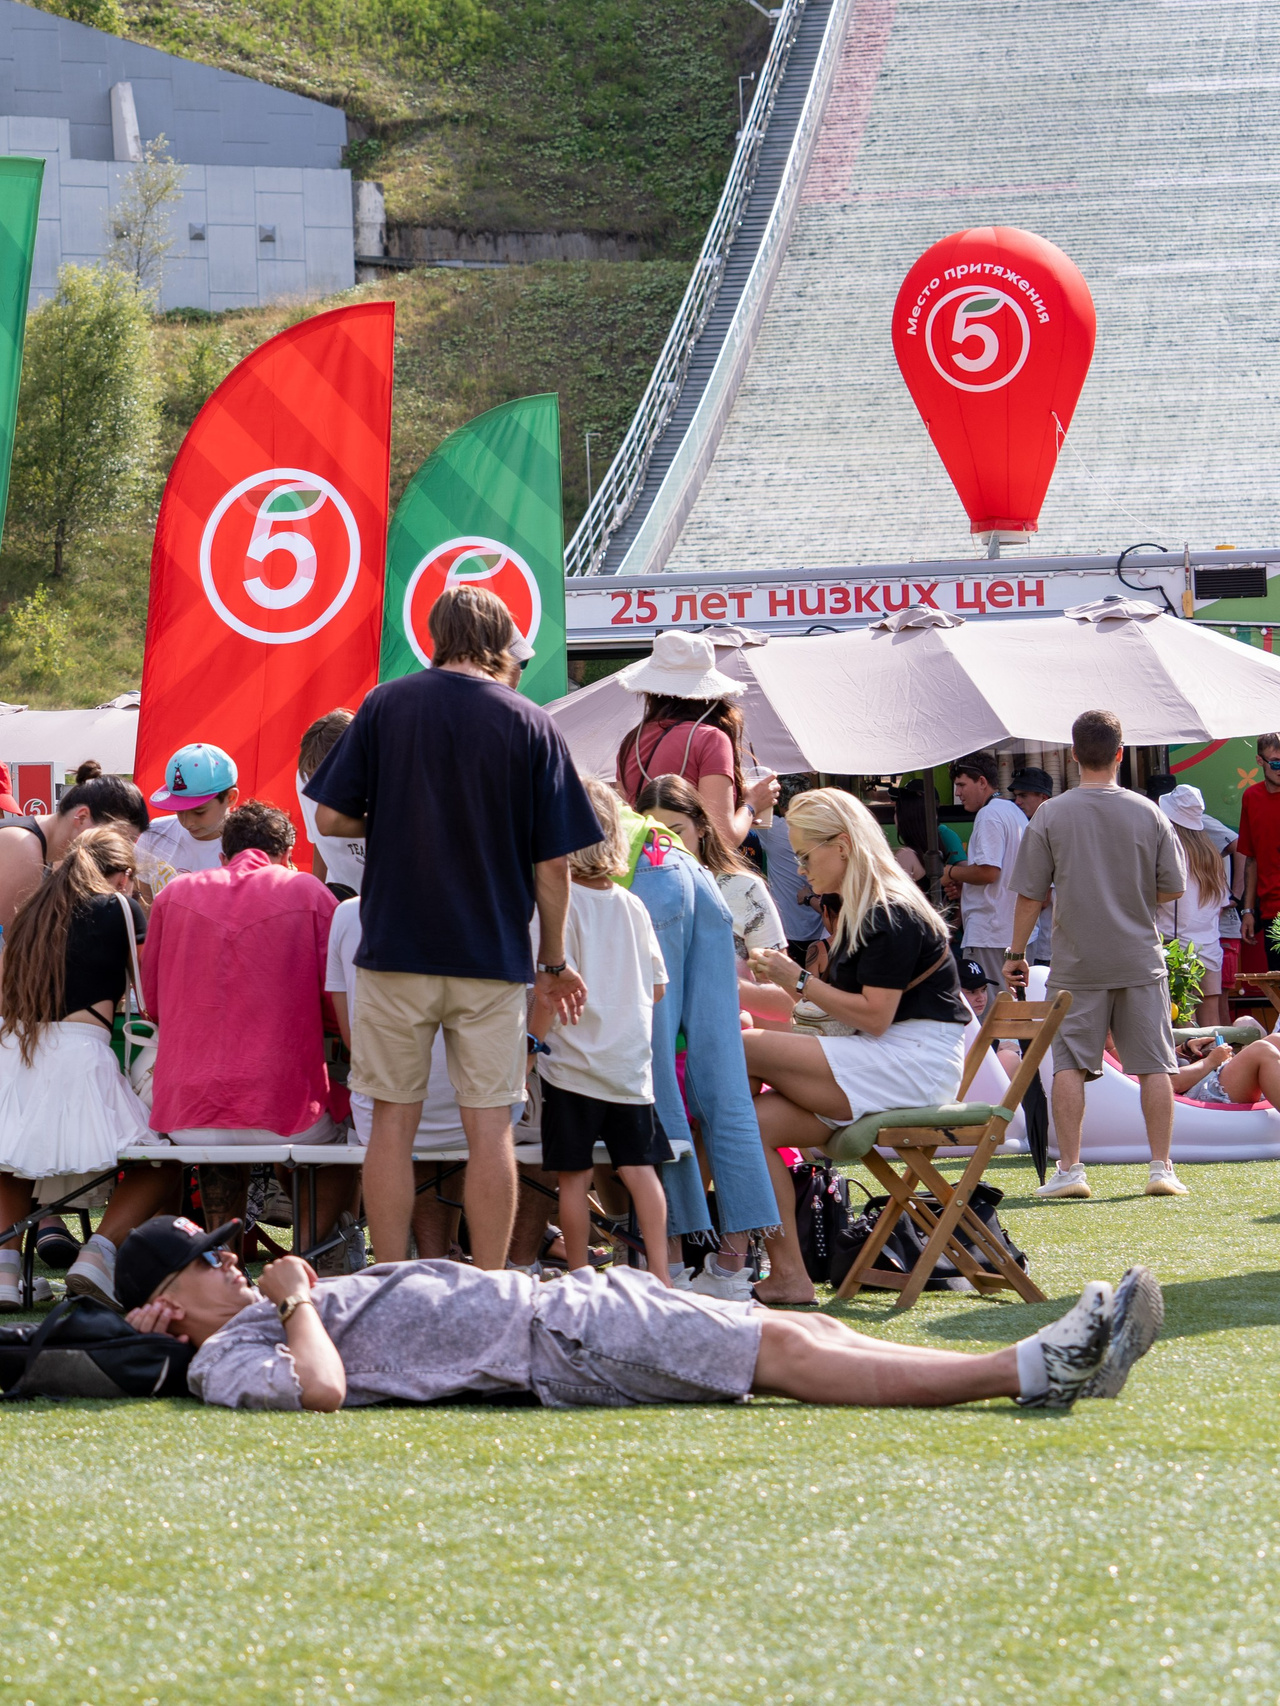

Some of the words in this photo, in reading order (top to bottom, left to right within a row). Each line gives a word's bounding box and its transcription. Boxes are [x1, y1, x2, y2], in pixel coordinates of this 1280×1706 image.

[906, 276, 940, 336] Место
[943, 262, 1050, 324] притяжения
[951, 292, 1008, 373] 5
[242, 480, 329, 610] 5
[610, 590, 658, 625] 25
[671, 590, 753, 622] лет
[768, 582, 938, 618] низких
[954, 578, 1045, 614] цен
